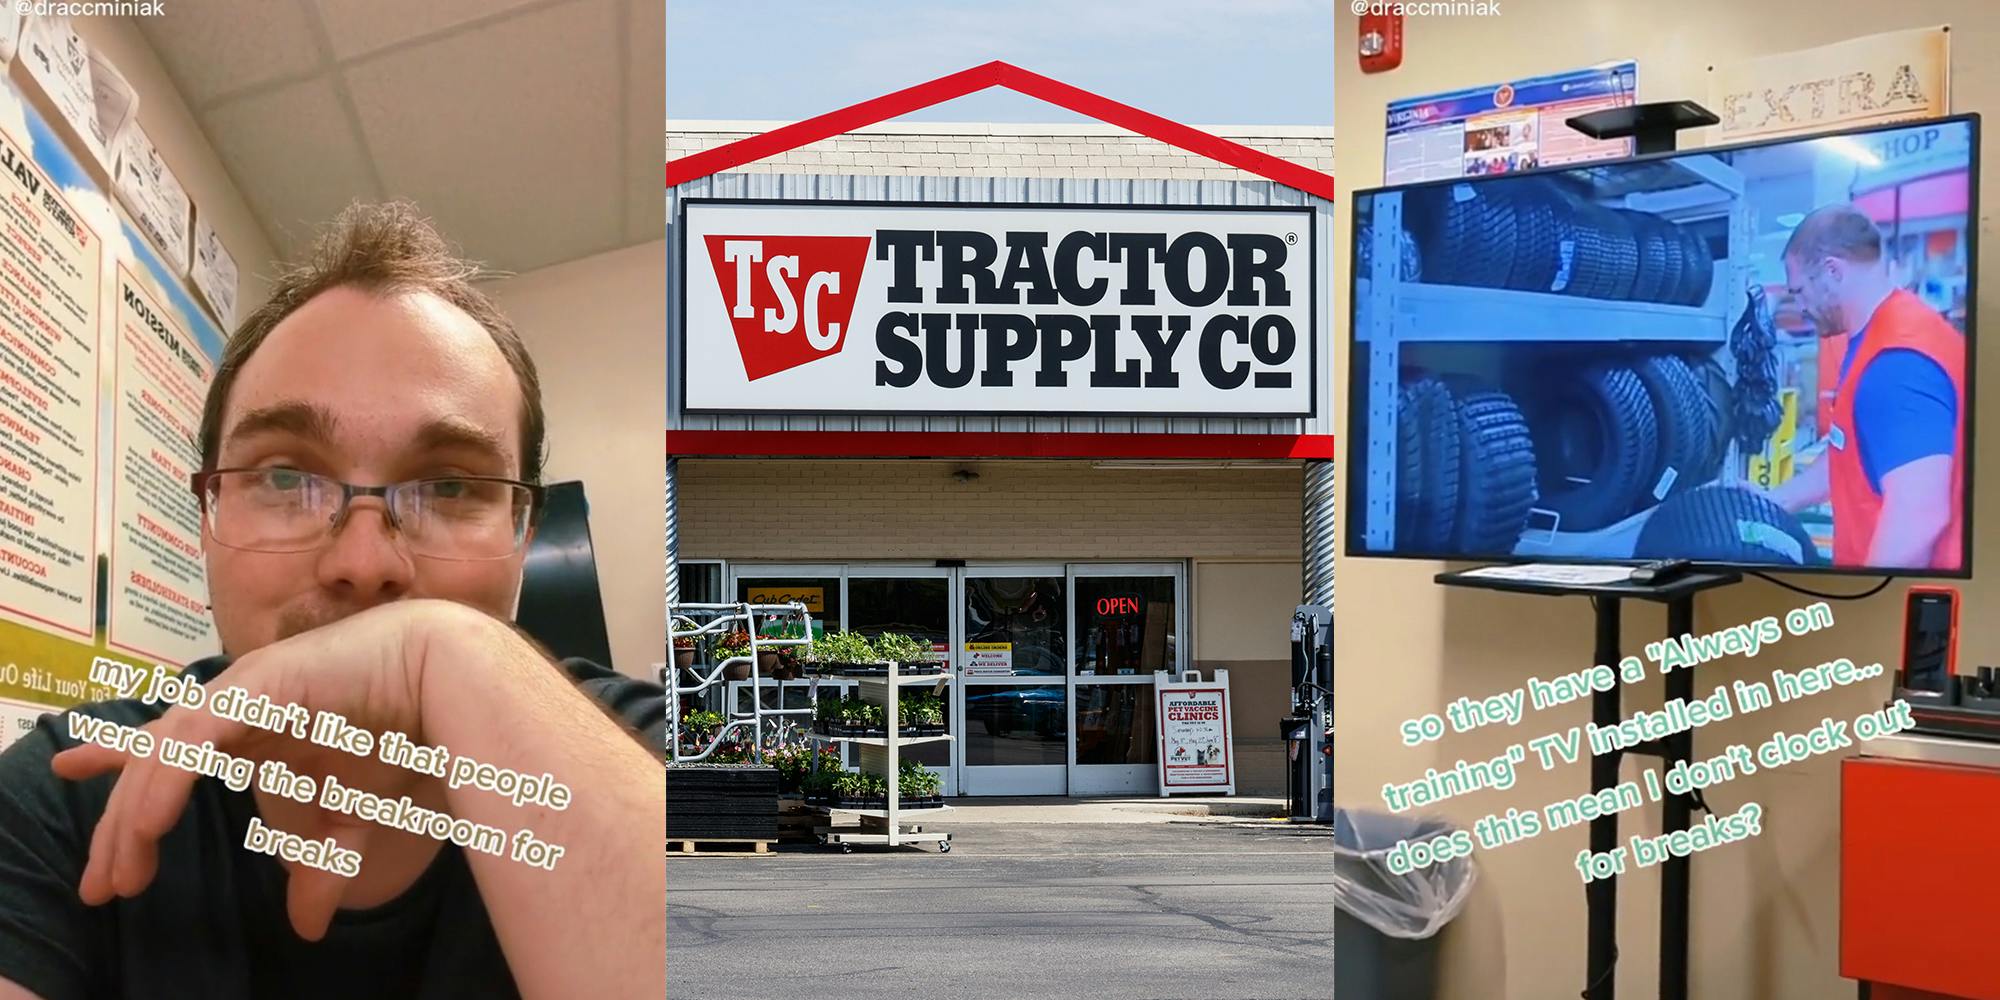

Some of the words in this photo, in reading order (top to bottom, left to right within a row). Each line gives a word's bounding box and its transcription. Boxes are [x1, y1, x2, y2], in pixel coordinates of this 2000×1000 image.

[1722, 65, 1929, 132] EXTRA
[724, 239, 841, 351] TSC
[875, 229, 1292, 308] TRACTOR
[875, 311, 1192, 388] SUPPLY
[1097, 597, 1139, 615] OPEN
[1168, 712, 1219, 720] CLINICS
